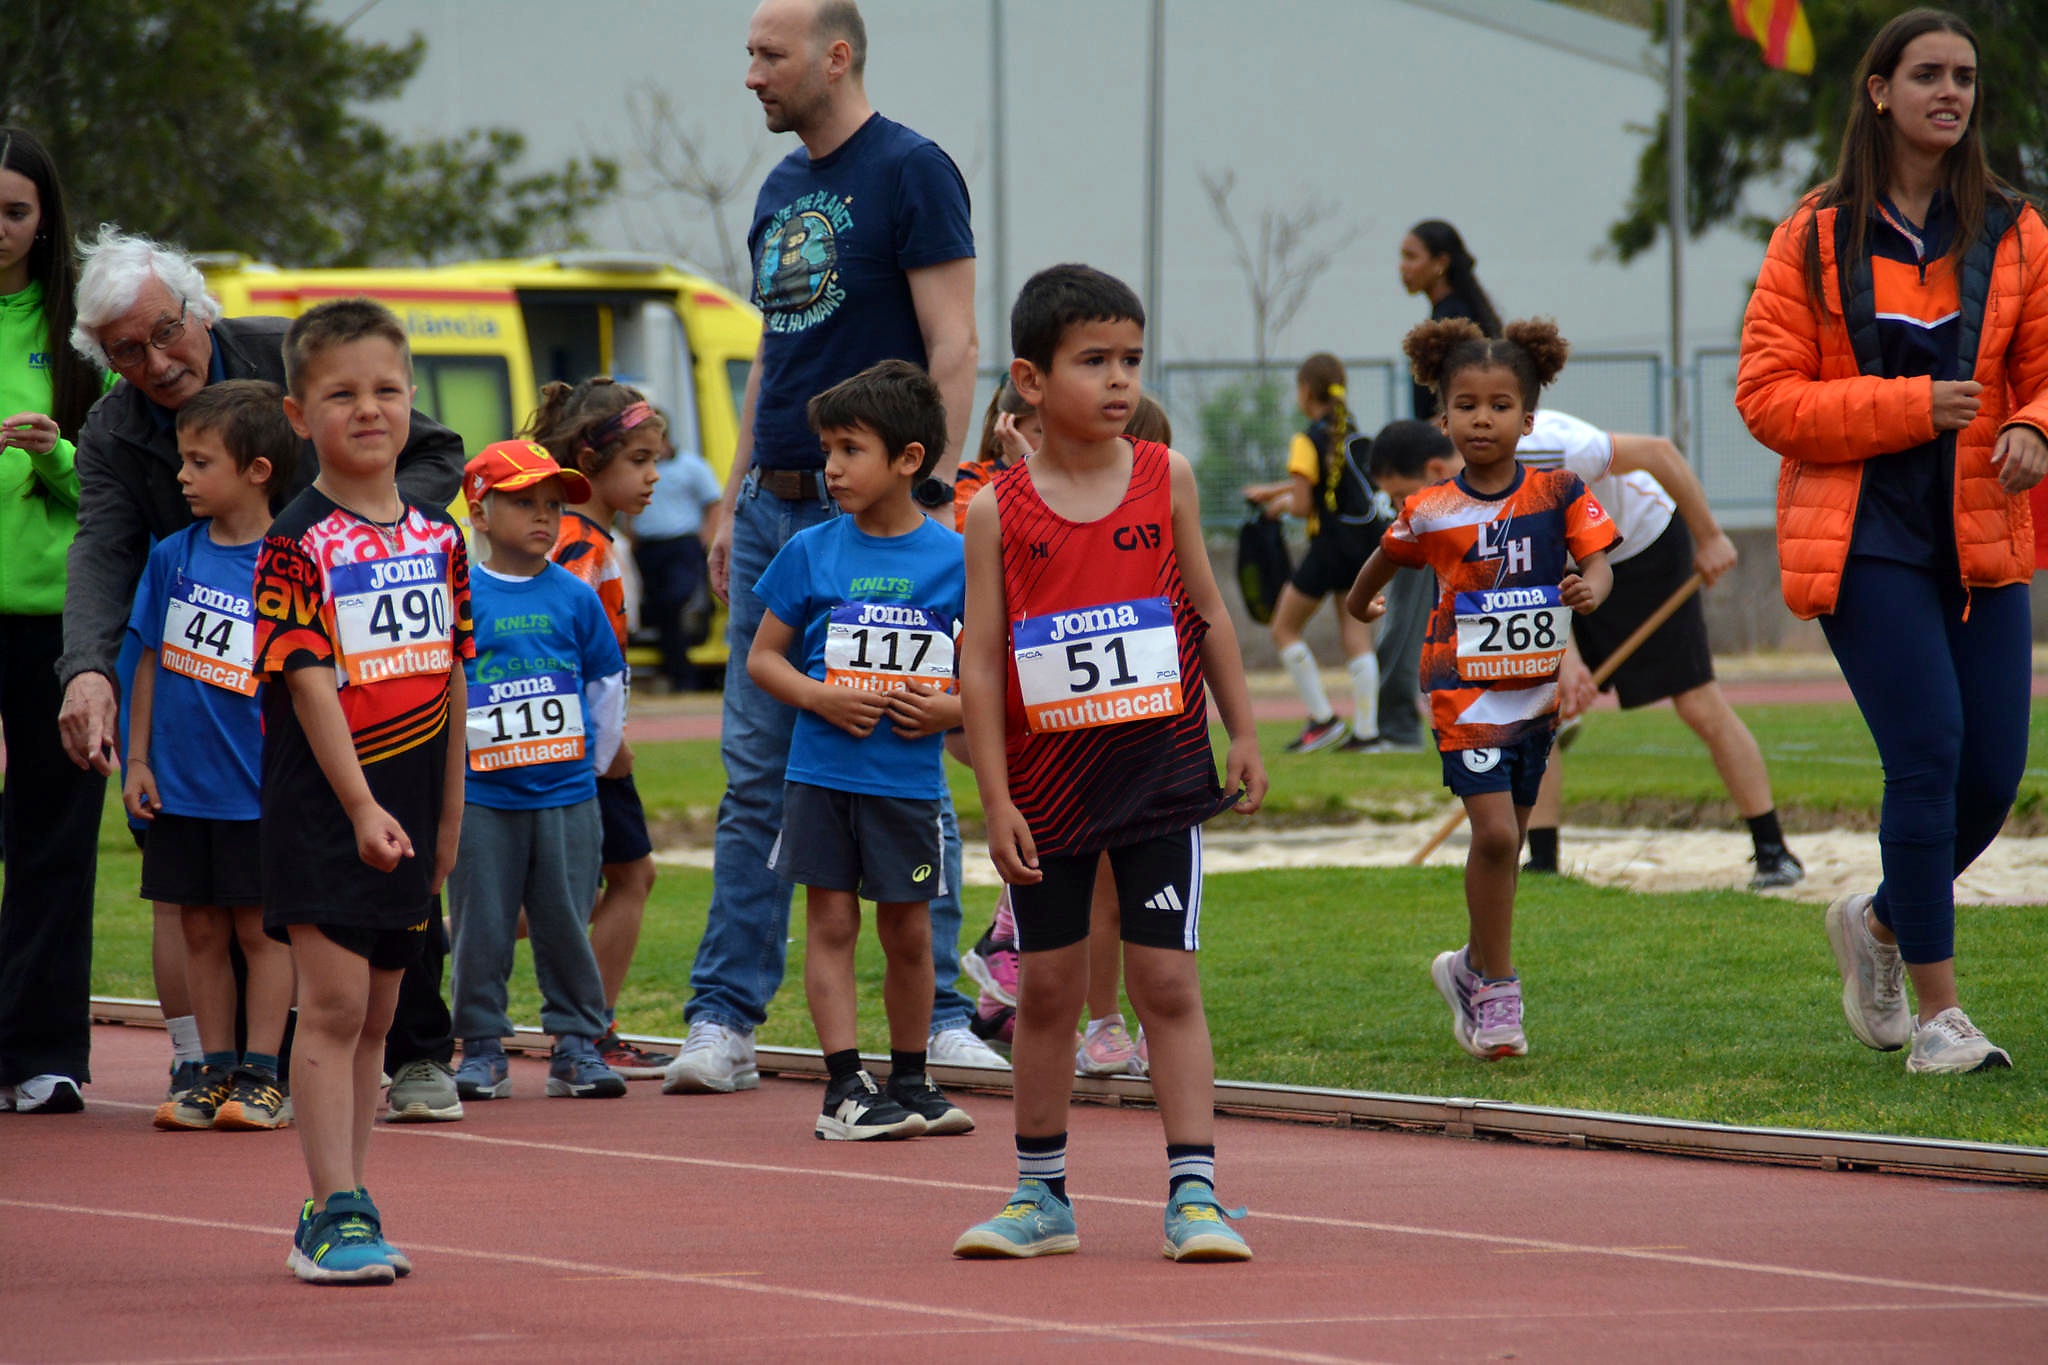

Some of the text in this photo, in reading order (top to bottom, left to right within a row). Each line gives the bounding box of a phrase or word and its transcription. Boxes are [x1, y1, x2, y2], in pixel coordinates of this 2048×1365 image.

[812, 190, 854, 233] PLANET
[786, 280, 846, 333] HUMANS
[851, 577, 910, 593] KNLTS
[185, 611, 234, 657] 44
[369, 587, 445, 642] 490
[494, 614, 549, 633] KNLTS
[1478, 611, 1556, 652] 268
[163, 649, 249, 690] mutuacat
[359, 649, 452, 680] mutuac
[850, 629, 933, 672] 117
[1066, 637, 1138, 693] 51
[488, 699, 565, 743] 119
[1039, 687, 1173, 730] mutuacat
[479, 739, 580, 769] mutuacat
